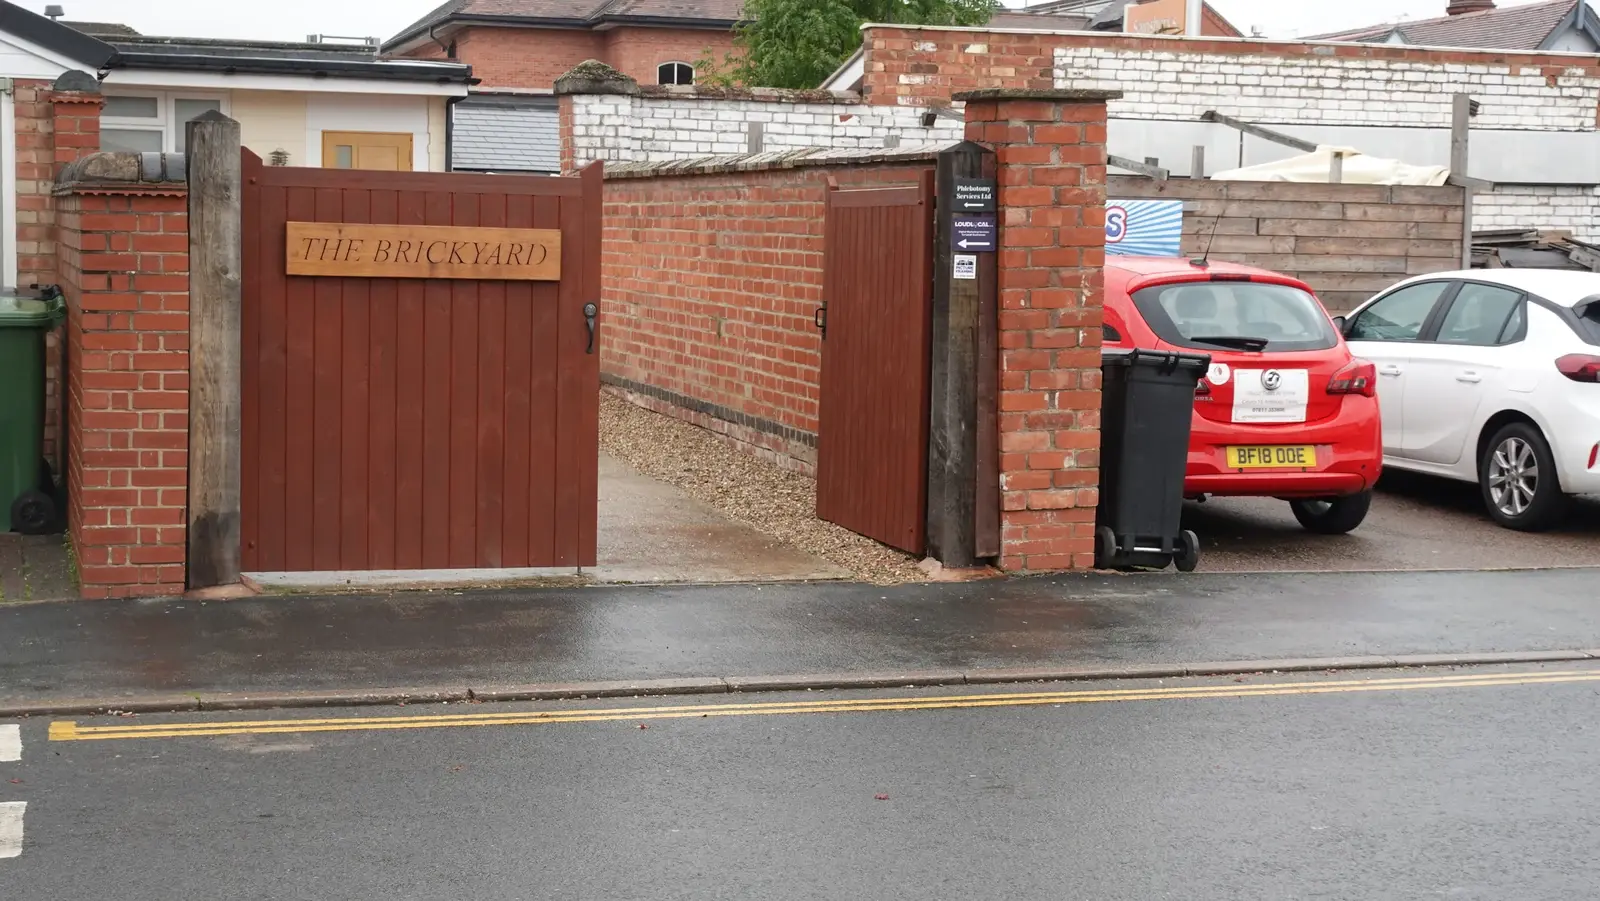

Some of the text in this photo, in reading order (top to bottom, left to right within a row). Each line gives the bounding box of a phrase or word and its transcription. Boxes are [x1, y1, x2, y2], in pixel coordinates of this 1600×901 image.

[956, 185, 991, 193] Phlebotomy
[303, 237, 547, 265] THE BRICKYARD
[1237, 448, 1272, 464] BF18
